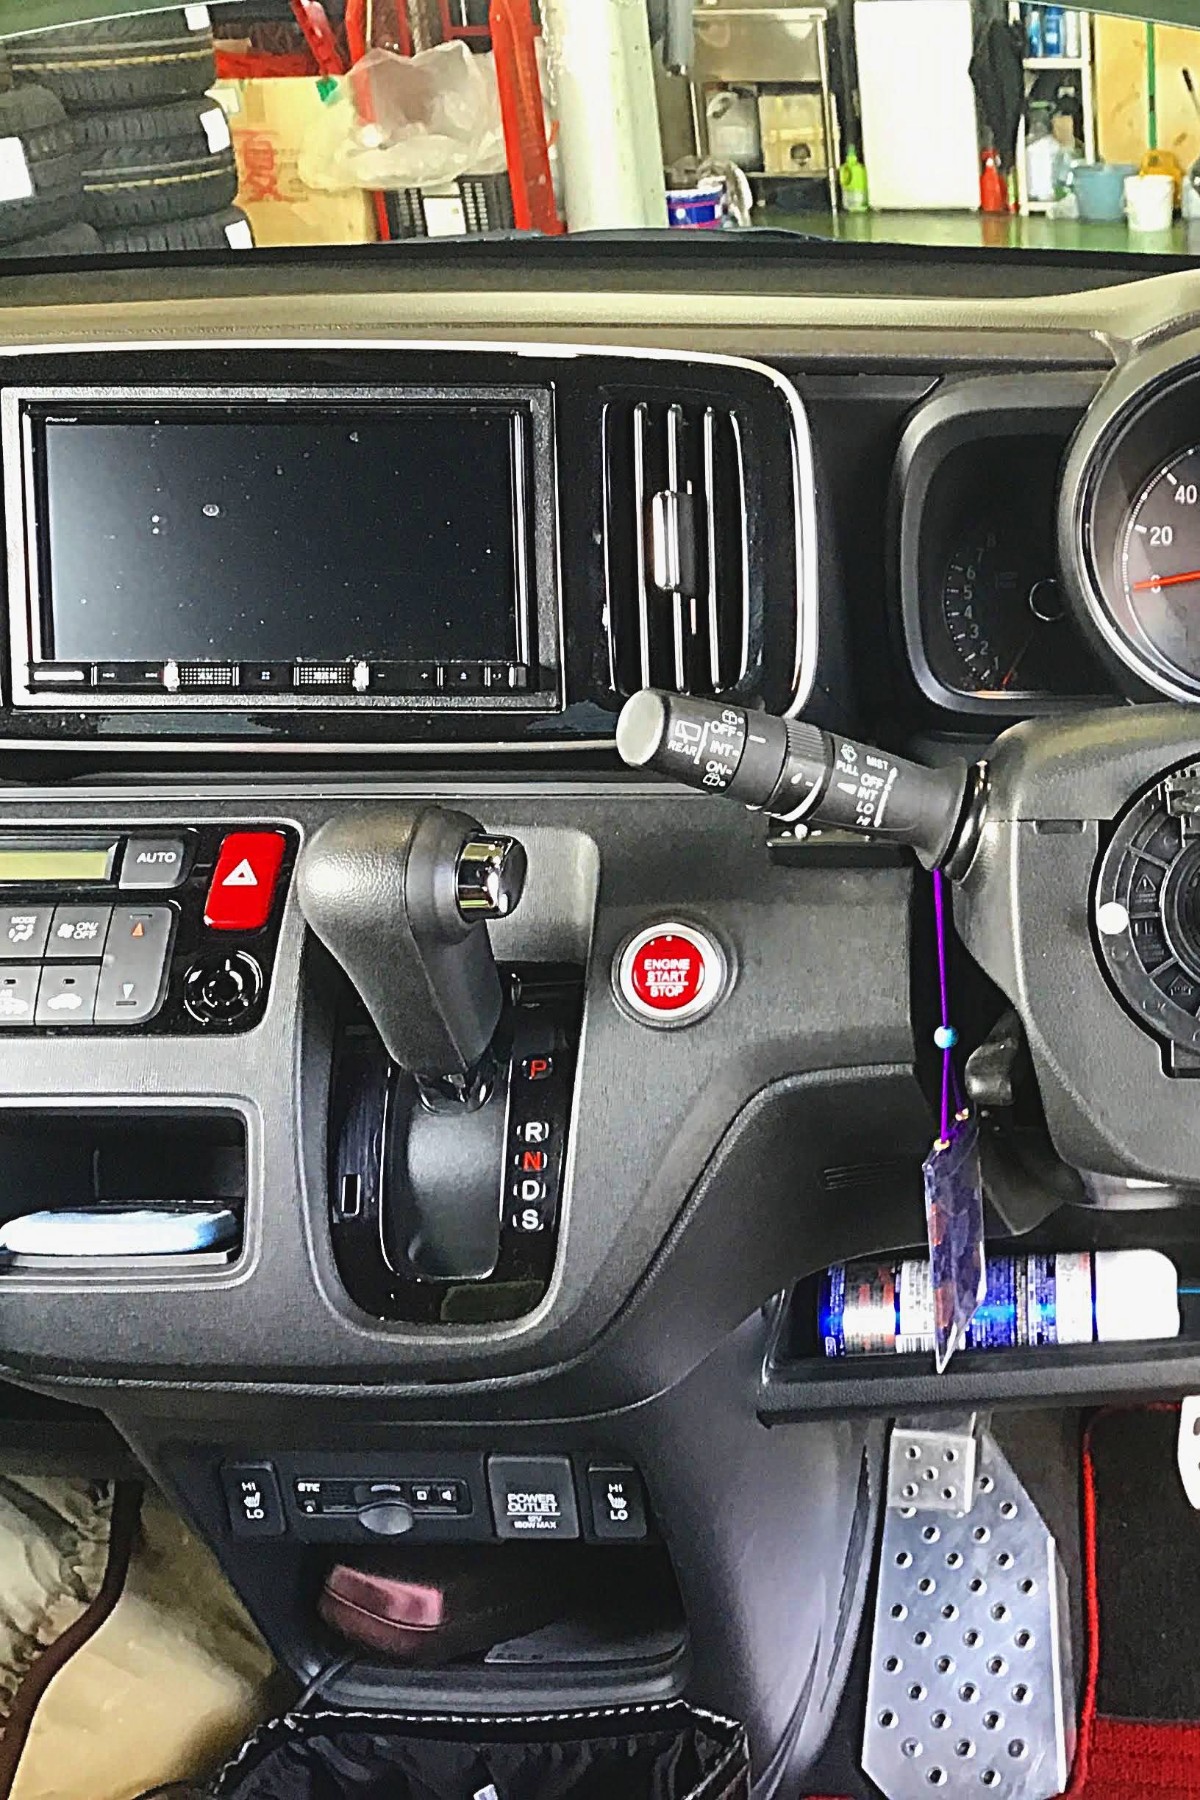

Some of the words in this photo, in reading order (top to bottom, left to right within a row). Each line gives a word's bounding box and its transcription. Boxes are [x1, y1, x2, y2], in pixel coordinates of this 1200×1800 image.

[1175, 484, 1197, 504] 40
[1150, 526, 1173, 546] 20
[966, 565, 976, 579] 6
[963, 585, 973, 600] 5
[964, 605, 973, 619] 4
[970, 624, 979, 639] 3
[980, 641, 989, 655] 2
[994, 656, 999, 670] 1
[711, 721, 736, 737] OFF
[667, 740, 698, 757] REAR
[709, 740, 734, 757] INT
[705, 760, 728, 776] ON
[836, 760, 859, 777] PULL
[866, 755, 889, 770] MIST
[860, 772, 884, 788] OFF
[856, 785, 879, 800] INT
[856, 802, 875, 815] LO
[136, 852, 177, 864] AUTO
[11, 916, 38, 925] MODE
[74, 930, 98, 940] OFF
[643, 958, 691, 970] ENGINE
[647, 970, 687, 982] START
[650, 985, 685, 997] STOP
[530, 1059, 548, 1079] P
[525, 1121, 543, 1142] R
[523, 1151, 541, 1171] N
[522, 1180, 540, 1200] D
[522, 1209, 540, 1230] S
[242, 1482, 256, 1491] HI
[297, 1483, 320, 1492] ETC
[608, 1484, 623, 1492] HI
[507, 1493, 556, 1503] POWER
[246, 1509, 264, 1519] LO
[507, 1503, 557, 1512] OUTLET
[610, 1510, 628, 1520] LO
[537, 1521, 556, 1529] MAX
